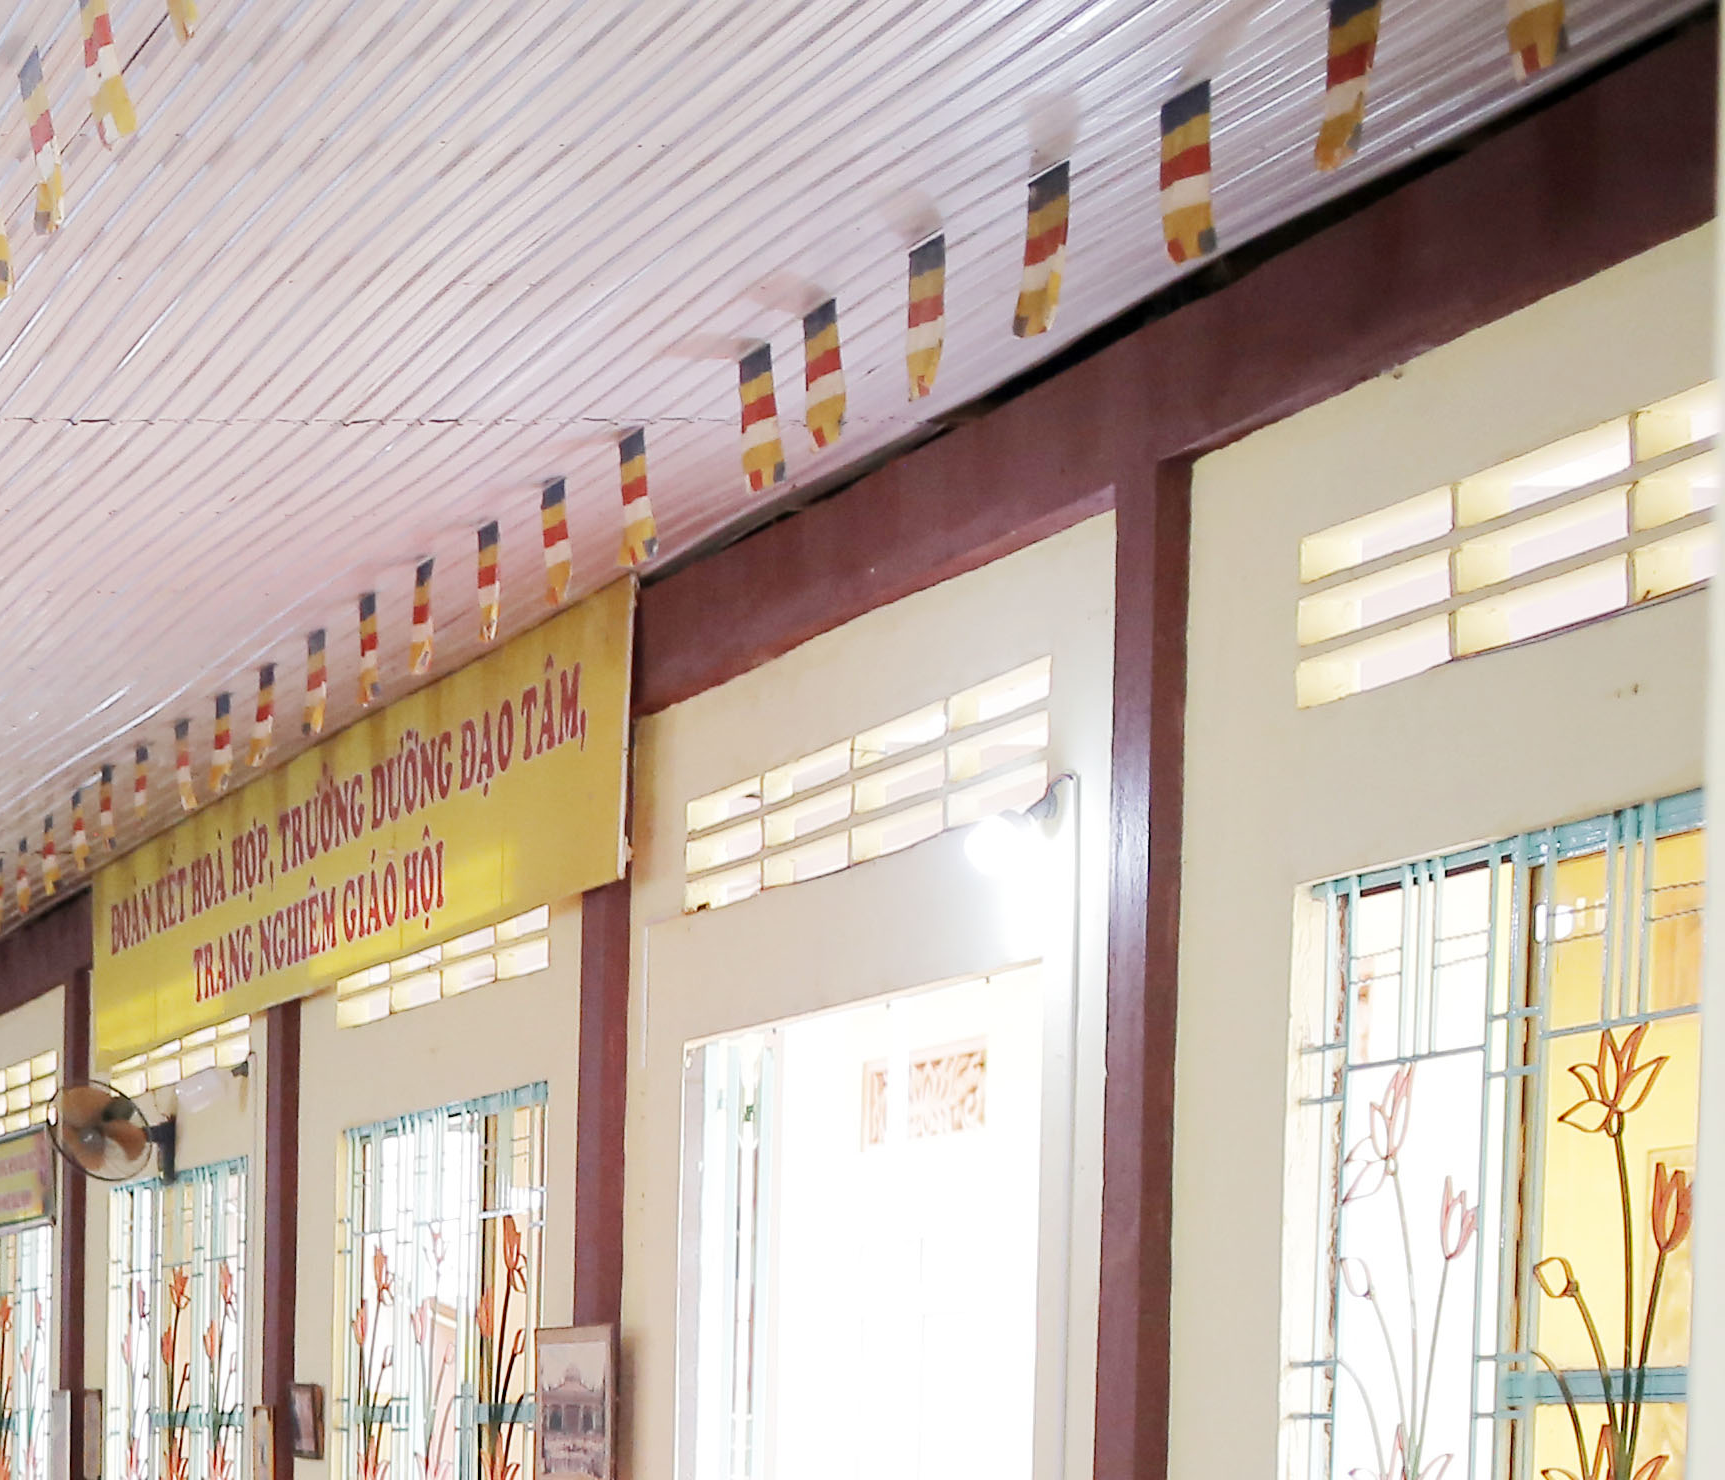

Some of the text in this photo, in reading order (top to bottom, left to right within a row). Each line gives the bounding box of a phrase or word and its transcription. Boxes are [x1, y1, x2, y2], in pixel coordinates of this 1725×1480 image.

[459, 698, 515, 798] ĐẠO
[520, 653, 587, 761] TÂM,
[193, 823, 445, 1003] TRANG NGHIÊM GIÁO HỘI
